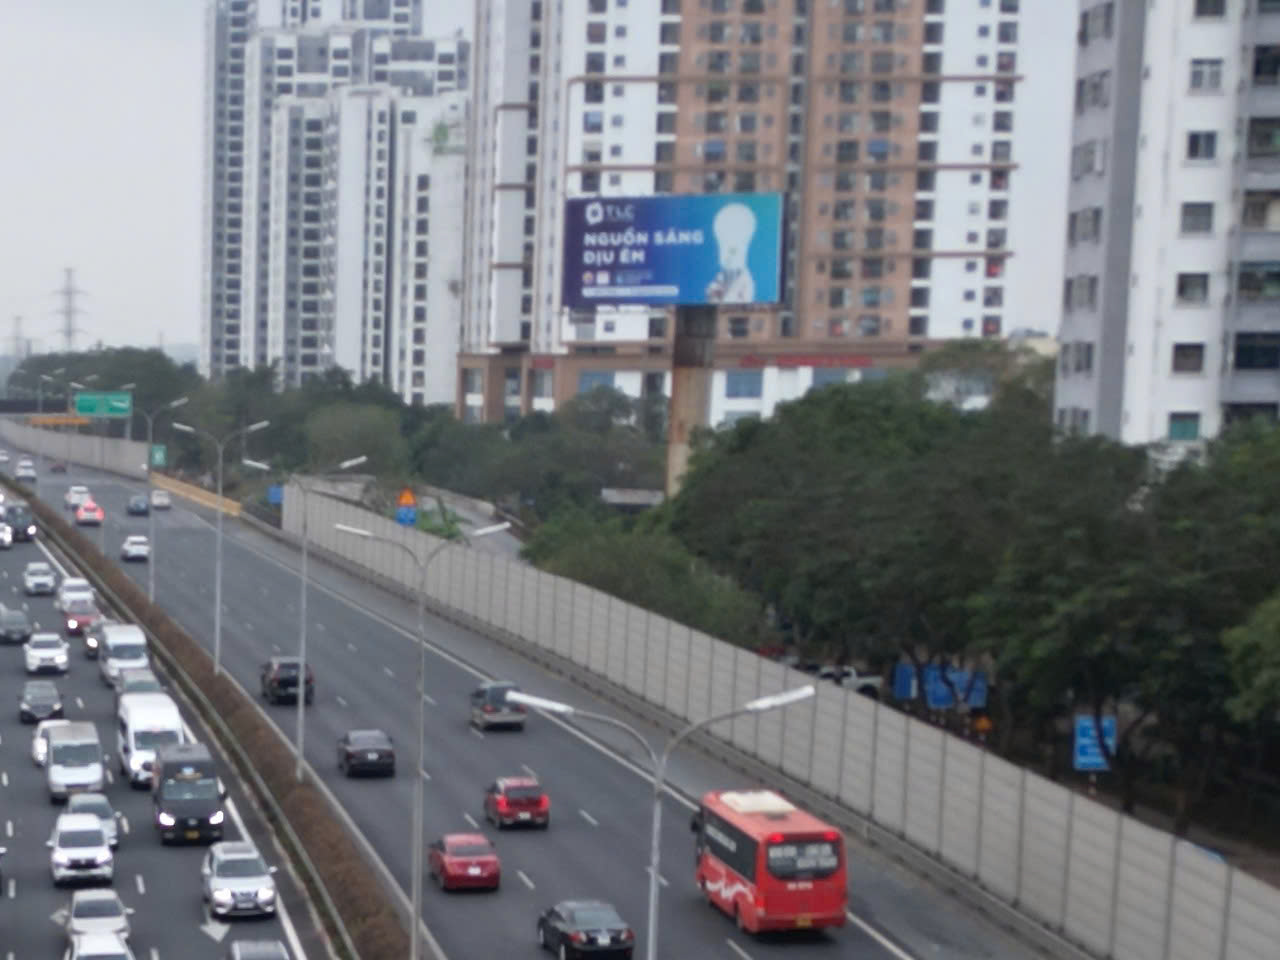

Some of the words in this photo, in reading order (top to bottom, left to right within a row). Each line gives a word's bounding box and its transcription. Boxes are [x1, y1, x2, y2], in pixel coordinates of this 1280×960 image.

[654, 228, 704, 245] SÁNG
[583, 249, 615, 266] DỊU
[619, 246, 646, 263] ÊM
